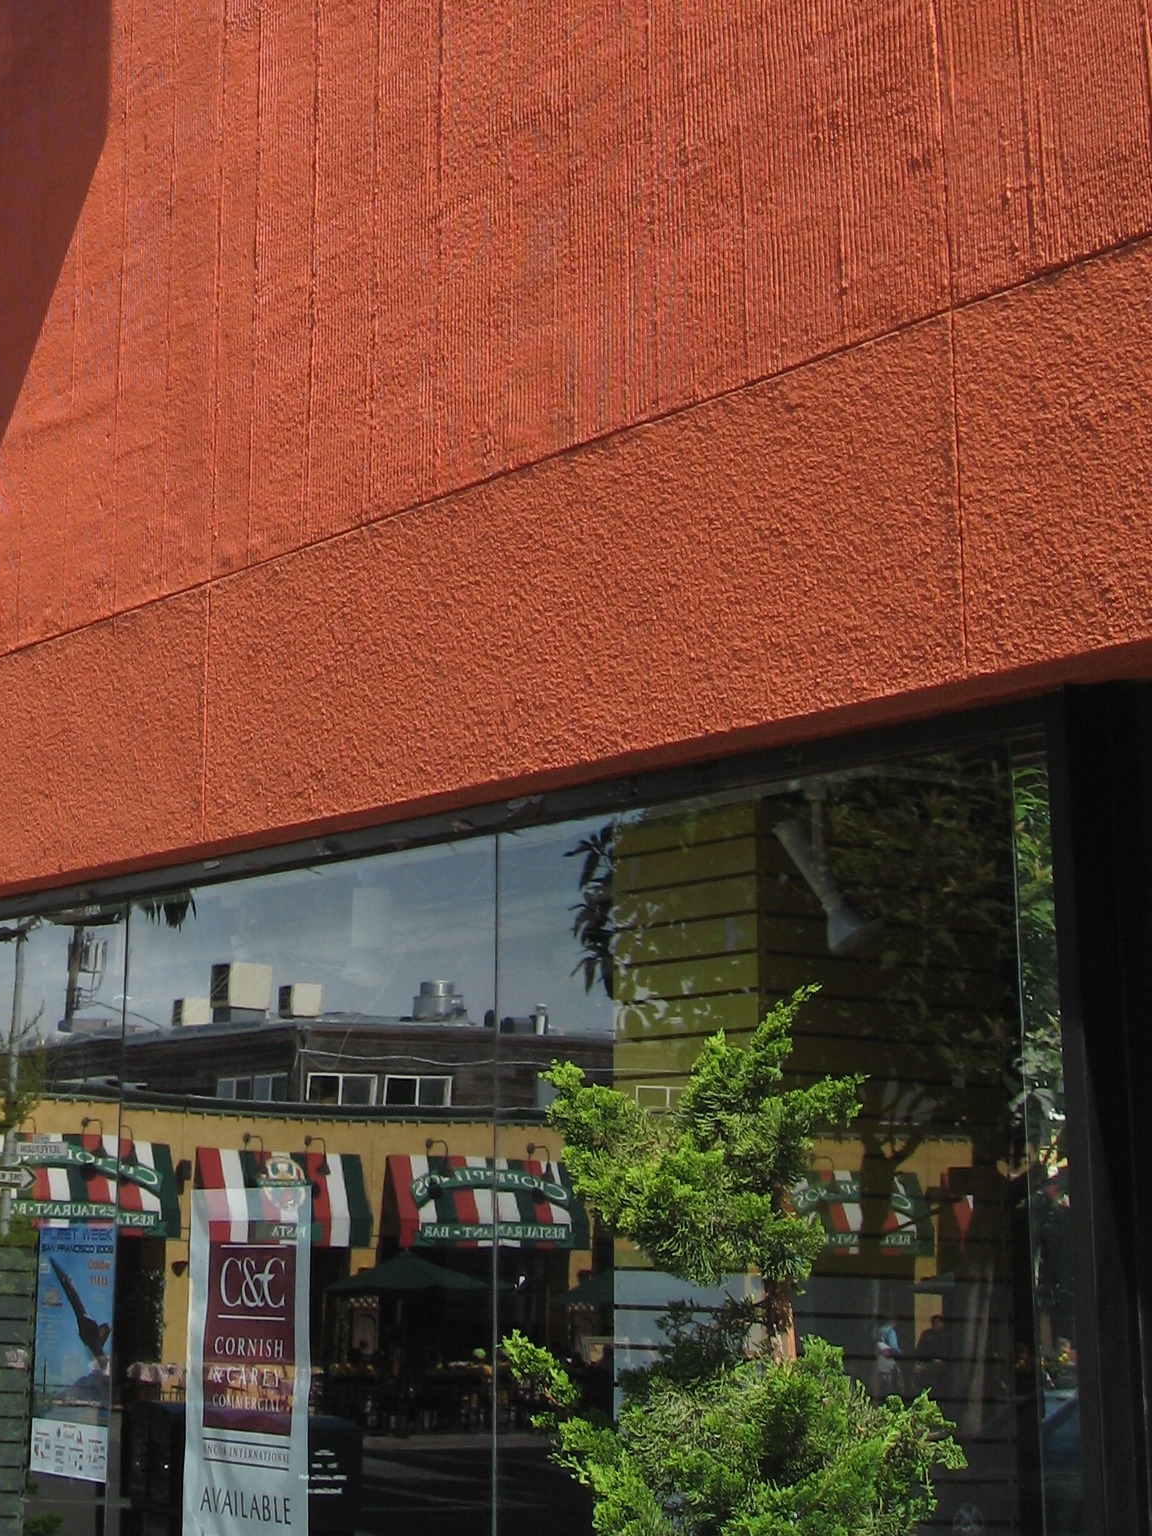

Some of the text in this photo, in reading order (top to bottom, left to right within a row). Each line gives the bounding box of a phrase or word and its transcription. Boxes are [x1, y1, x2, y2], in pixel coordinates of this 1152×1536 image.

[42, 1228, 113, 1241] FLEET WEEK
[41, 1244, 56, 1253] SAN
[214, 1336, 284, 1358] CORNISH
[212, 1393, 282, 1413] COMMERCIAL
[229, 1446, 290, 1463] INTERNATIONAL
[200, 1485, 292, 1525] AVAILABLE
